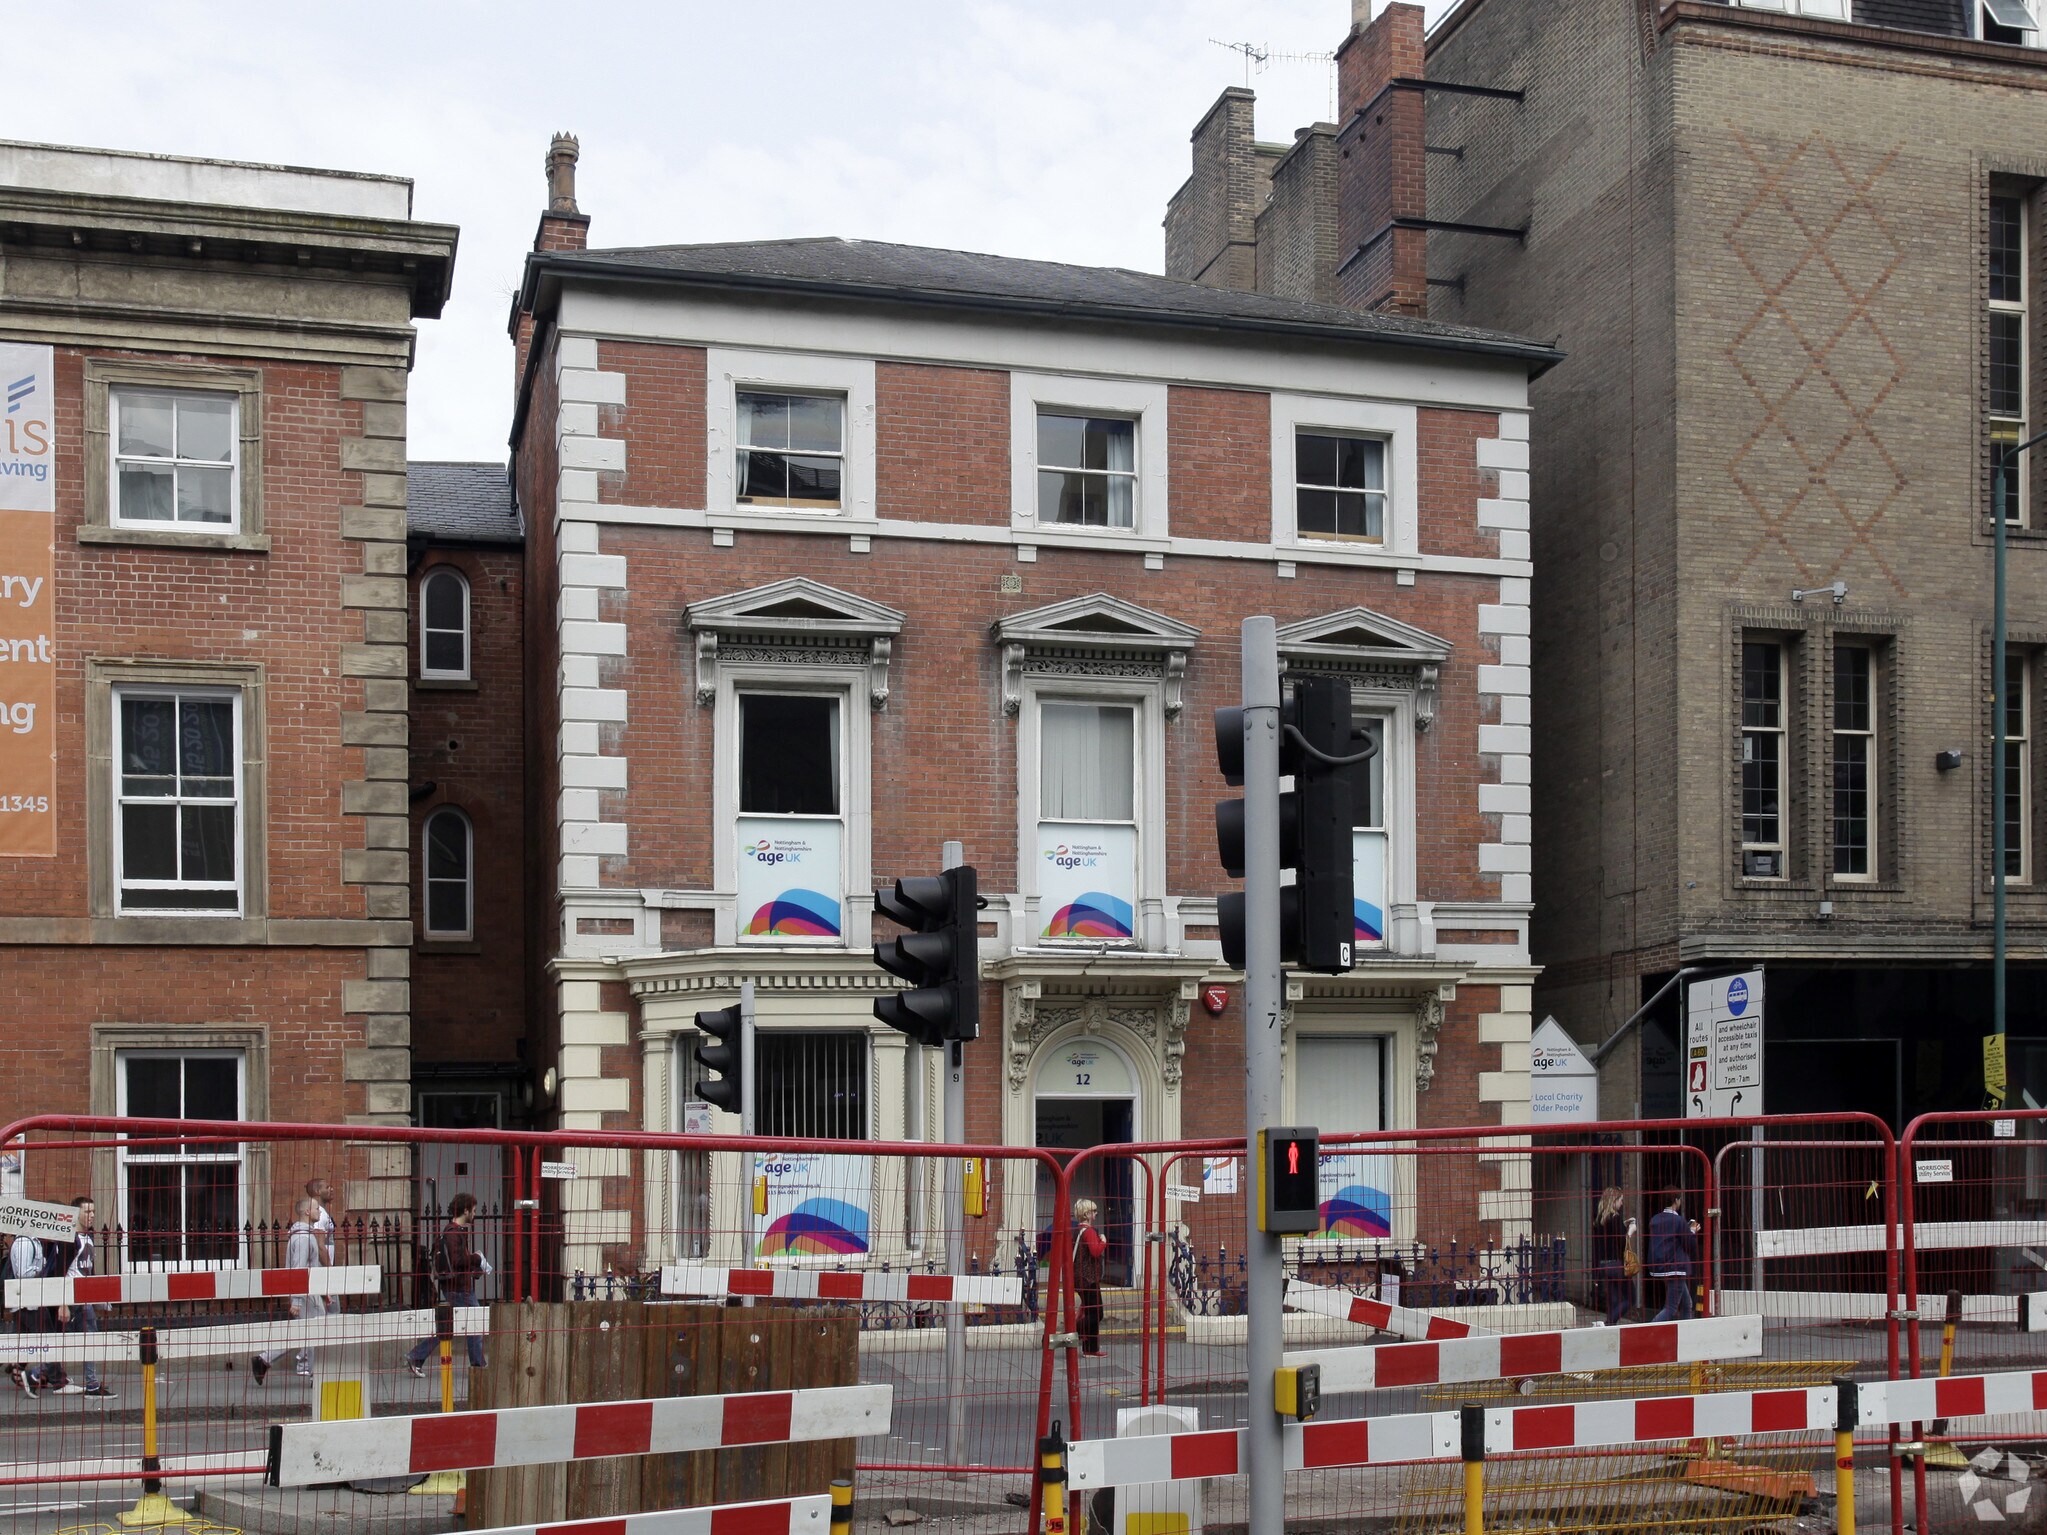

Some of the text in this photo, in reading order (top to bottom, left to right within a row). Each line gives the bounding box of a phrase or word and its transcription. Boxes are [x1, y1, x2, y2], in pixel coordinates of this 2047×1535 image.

[0, 459, 48, 481] ving
[0, 575, 43, 607] ry
[757, 852, 801, 866] age UK
[1056, 857, 1096, 870] age UK
[1267, 1012, 1277, 1029] 7
[1695, 1022, 1704, 1031] All
[1719, 1021, 1757, 1034] and wheelchair
[1690, 1034, 1708, 1044] routes
[1718, 1031, 1758, 1043] accessible taxis
[1730, 1044, 1739, 1052] any
[1740, 1041, 1752, 1049] time
[1729, 1052, 1757, 1062] authorised
[1533, 1058, 1568, 1070] age UK
[1727, 1064, 1748, 1072] vehicles
[952, 1073, 960, 1083] 9
[1076, 1073, 1090, 1085] 12
[1535, 1092, 1583, 1102] Local Charity
[1532, 1103, 1580, 1113] Older People
[765, 1163, 808, 1177] age UK
[0, 1214, 72, 1233] tility Services
